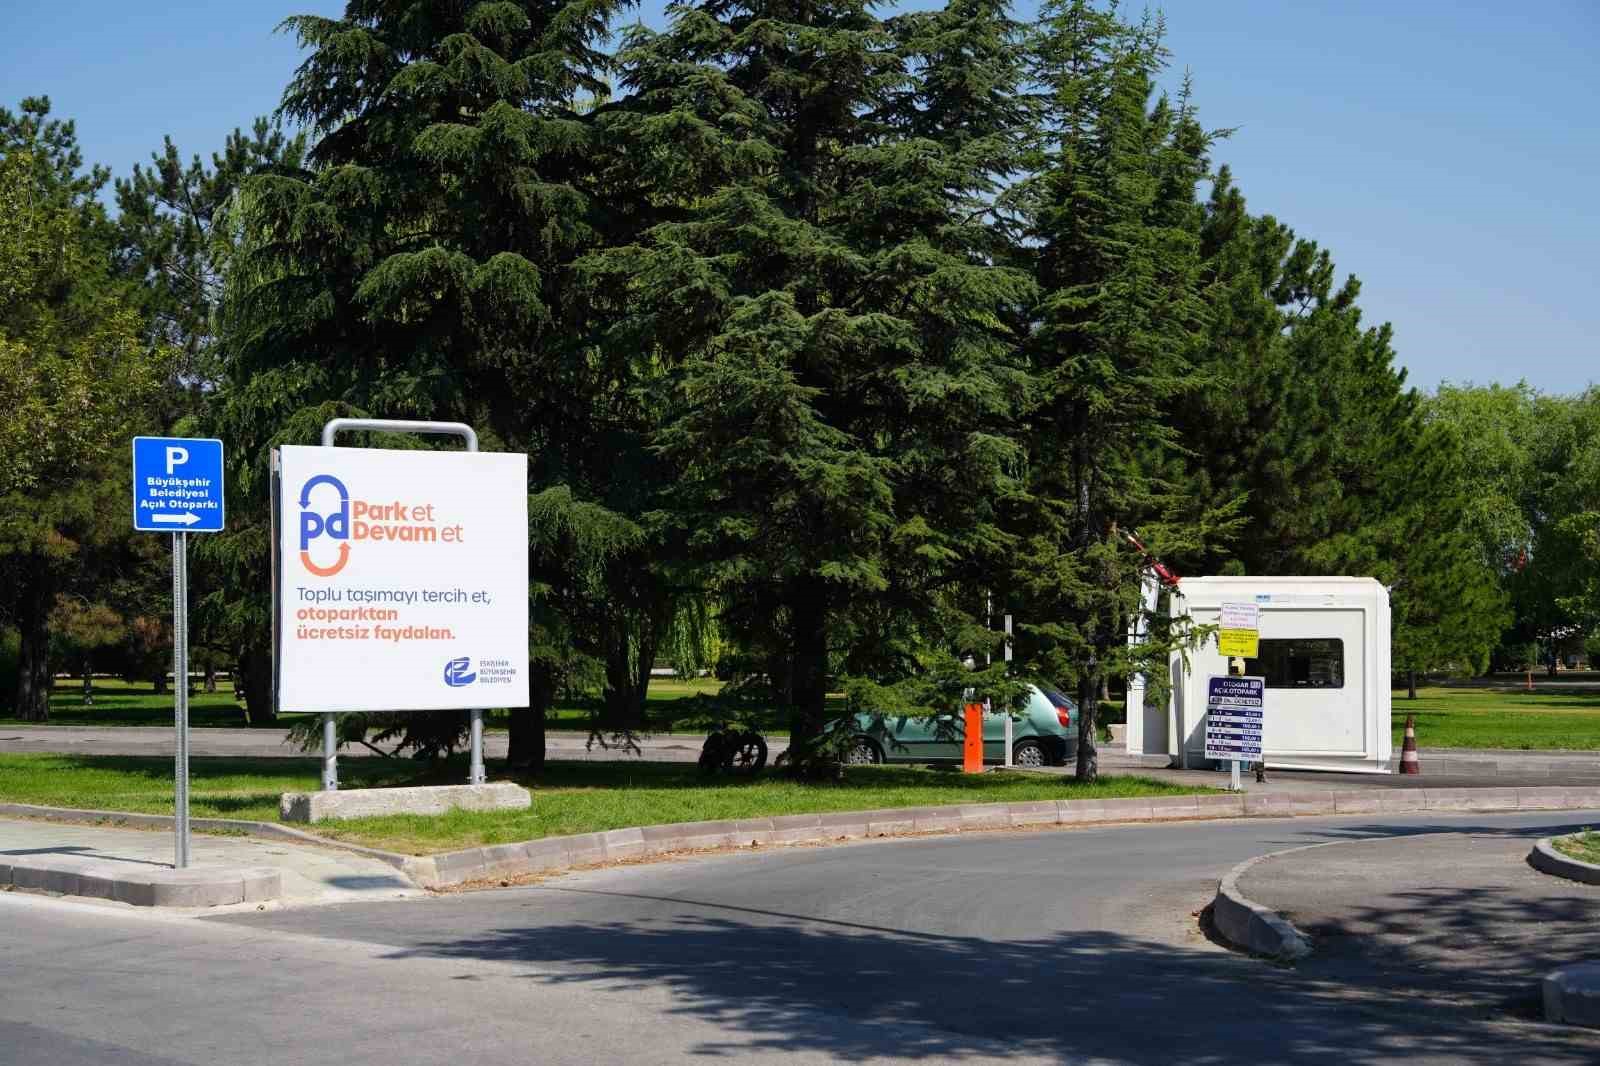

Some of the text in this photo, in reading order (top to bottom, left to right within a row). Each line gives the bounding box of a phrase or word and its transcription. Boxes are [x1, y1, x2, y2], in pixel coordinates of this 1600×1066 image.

[166, 446, 189, 475] P
[147, 477, 211, 488] Büyükşehir
[150, 488, 209, 499] Belediyesi
[140, 499, 218, 510] Açık Otoparkı
[353, 501, 435, 522] Park et
[353, 522, 464, 543] Devam et
[297, 587, 492, 606] Toplu taşımayı tercih et,
[297, 607, 398, 623] otoparktan
[297, 625, 456, 643] ücretsiz faydalan.
